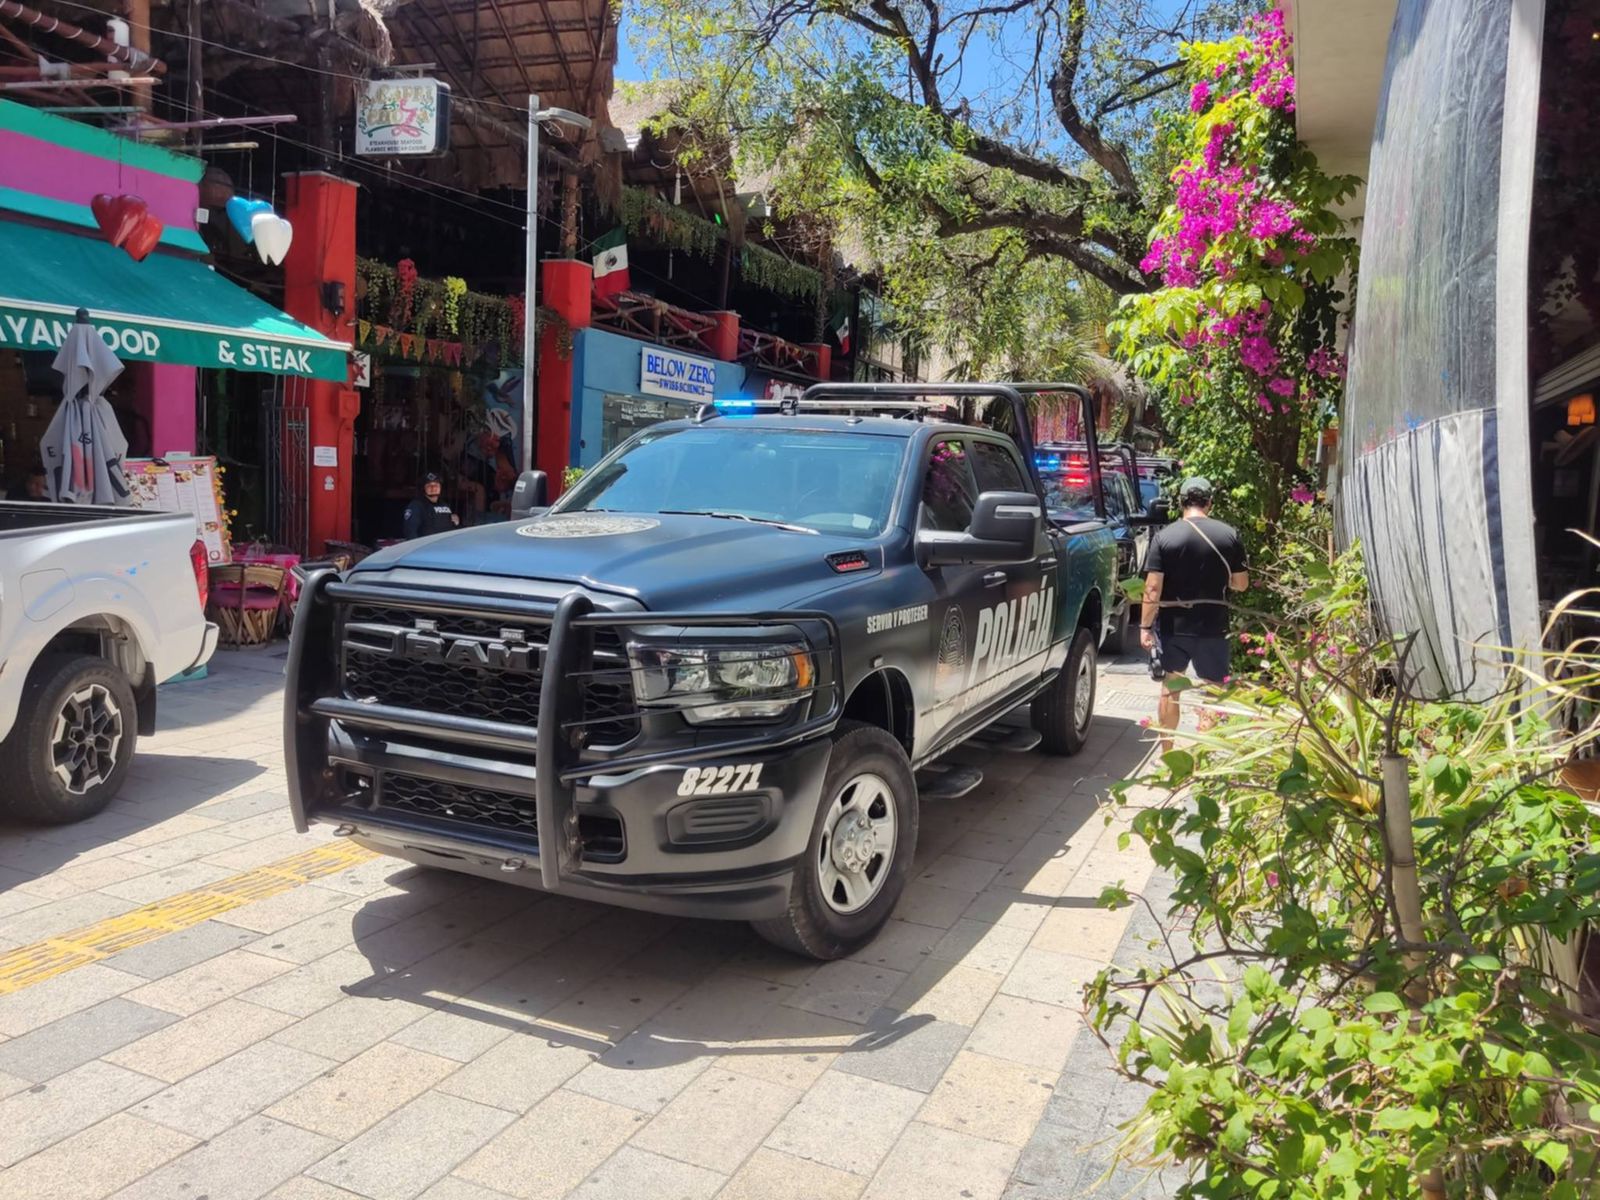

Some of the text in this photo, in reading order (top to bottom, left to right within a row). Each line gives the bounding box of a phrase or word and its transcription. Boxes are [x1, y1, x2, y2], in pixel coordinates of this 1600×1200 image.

[90, 324, 161, 356] OOD
[218, 340, 237, 365] &
[242, 343, 313, 373] STEAK
[647, 354, 717, 385] BELOW ZERO
[866, 604, 929, 634] SERVIR Y PROTEGER
[966, 574, 1055, 689] POLICÍA
[405, 633, 531, 671] RAM
[677, 762, 764, 796] 82271
